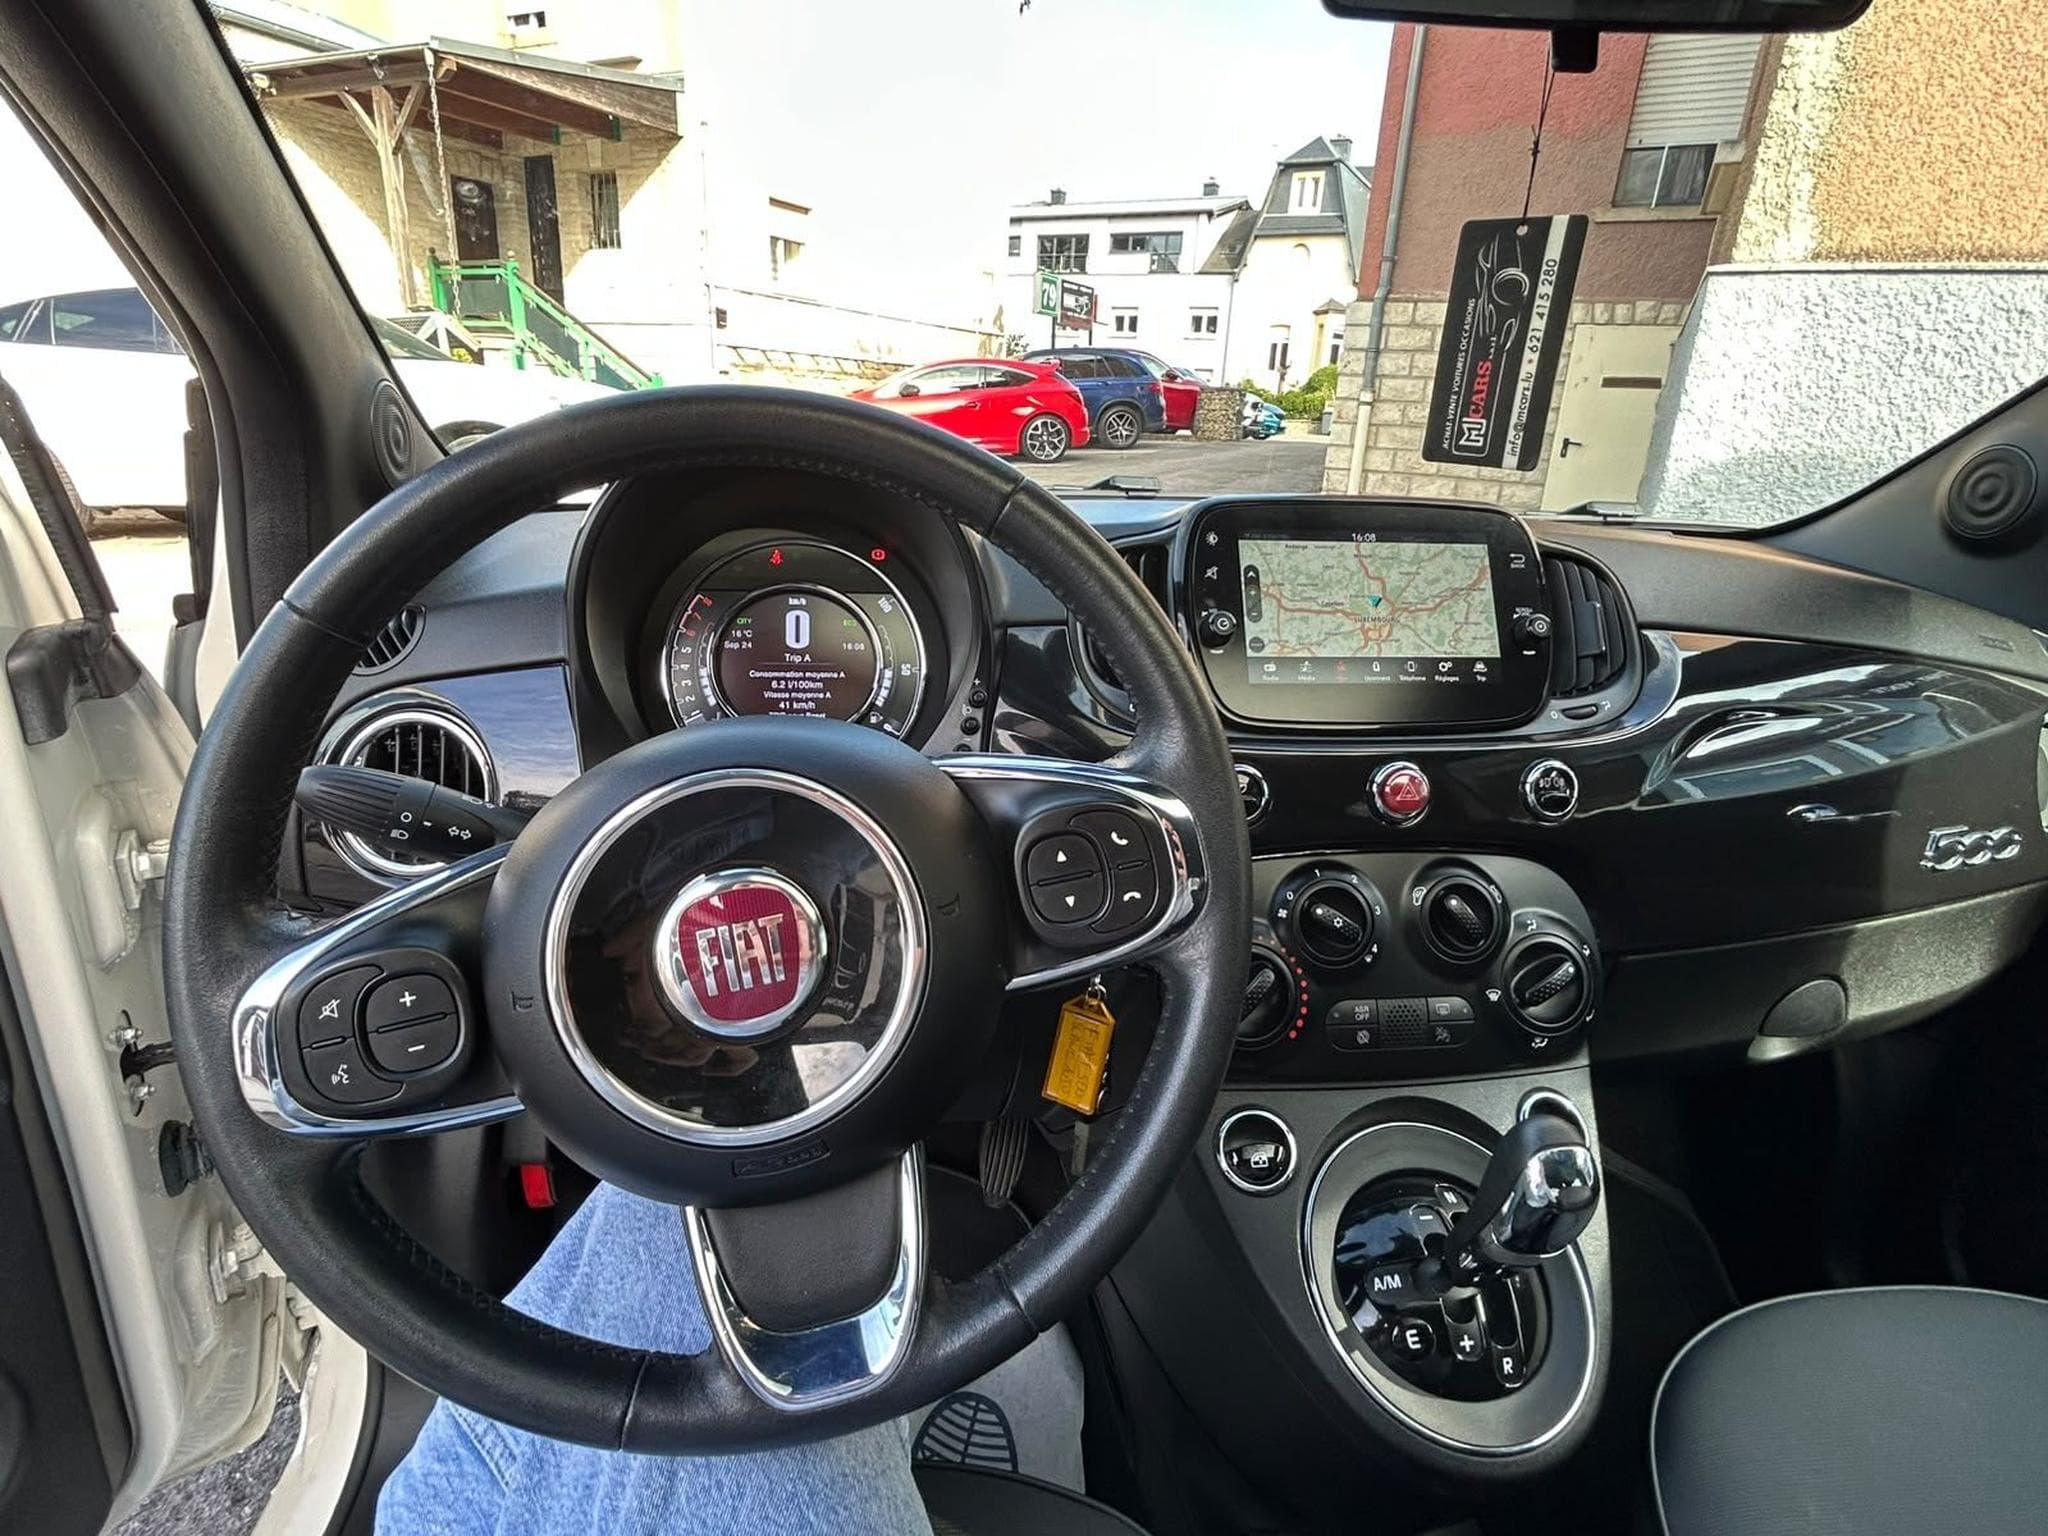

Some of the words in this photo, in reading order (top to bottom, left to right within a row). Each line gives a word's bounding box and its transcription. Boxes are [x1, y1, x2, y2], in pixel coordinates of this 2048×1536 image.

[1541, 258, 1558, 288] 280
[1042, 282, 1057, 308] 79
[1535, 291, 1551, 320] 415
[1460, 298, 1475, 350] OCCASIONS
[1526, 326, 1543, 354] 621
[1351, 532, 1377, 542] 16:08
[785, 609, 811, 650] 0
[724, 640, 740, 650] Sep
[741, 641, 752, 649] 24
[784, 653, 802, 663] Trip
[803, 654, 811, 662] A
[749, 670, 804, 679] Consommation
[805, 671, 838, 680] moyenne
[771, 680, 786, 689] 6.2
[763, 690, 790, 699] Vitesse
[791, 691, 824, 700] moyenne
[825, 691, 832, 699] A
[779, 701, 790, 709] 41
[792, 701, 816, 709] km/h
[1919, 824, 2022, 871] 500
[1350, 874, 1359, 884] 2
[1374, 905, 1382, 915] 3
[696, 913, 786, 997] FIAT
[1354, 1004, 1370, 1013] ASR
[1354, 1012, 1370, 1021] OFF
[1373, 1275, 1402, 1292] A/M
[1405, 1328, 1421, 1349] E
[1503, 1356, 1514, 1374] R
